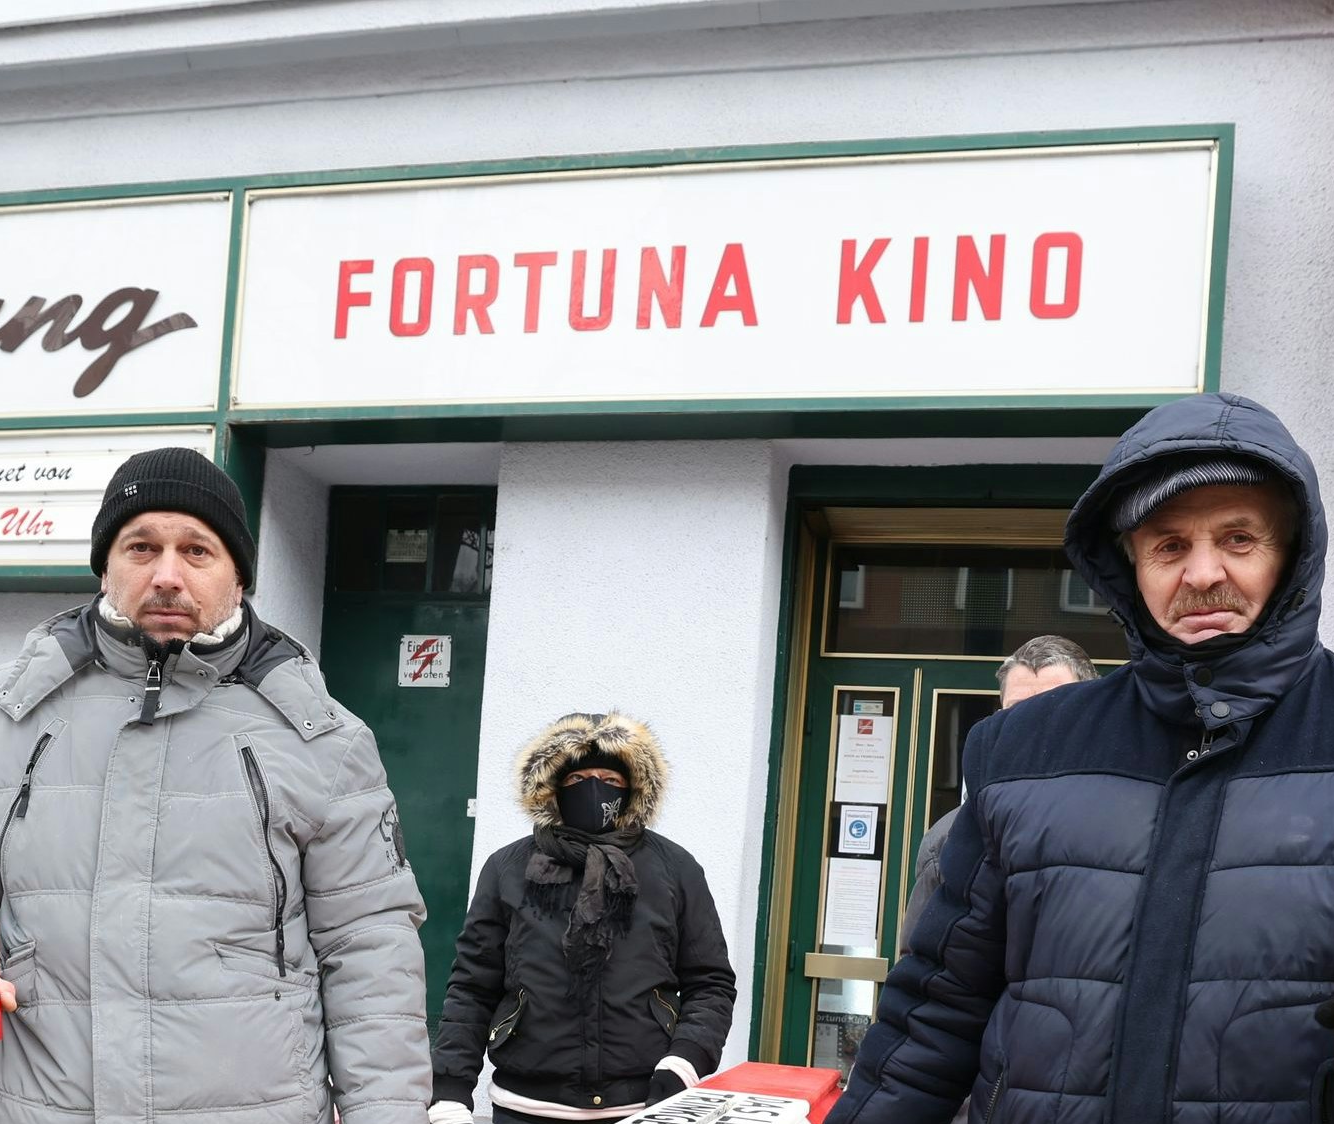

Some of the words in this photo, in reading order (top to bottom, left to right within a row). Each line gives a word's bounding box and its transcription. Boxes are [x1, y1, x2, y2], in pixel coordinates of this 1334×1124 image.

[334, 243, 759, 340] FORTUNA
[836, 231, 1084, 324] KINO
[34, 465, 73, 482] von
[0, 506, 55, 537] Uhr
[817, 1014, 846, 1023] ortuna
